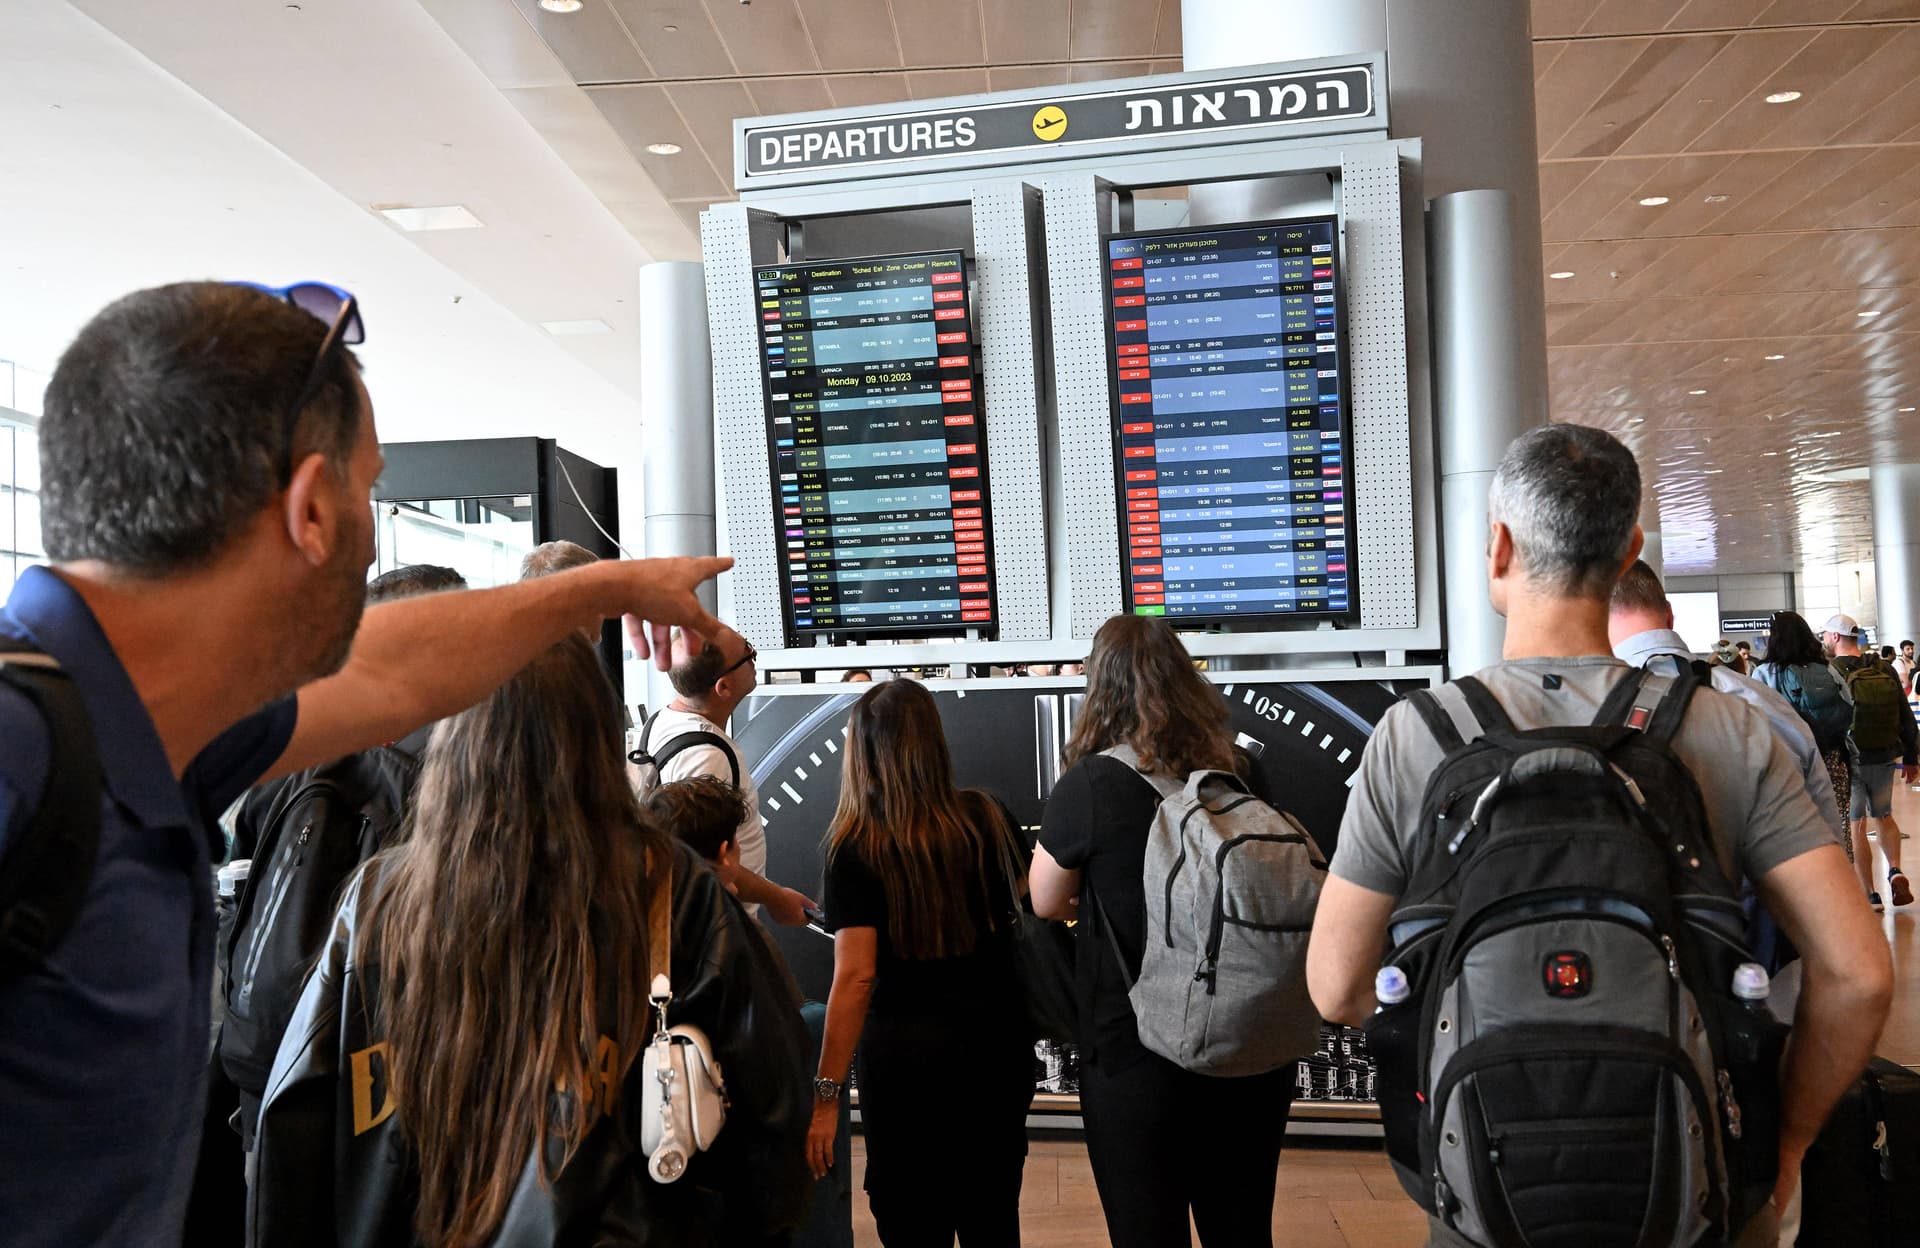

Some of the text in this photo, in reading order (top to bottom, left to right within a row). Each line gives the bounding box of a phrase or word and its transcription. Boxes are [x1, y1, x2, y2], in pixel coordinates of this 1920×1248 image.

[1126, 80, 1350, 130] המראות
[760, 118, 977, 166] DEPARTURES
[828, 373, 911, 386] Monday 09.10.2023
[1255, 696, 1284, 721] 05
